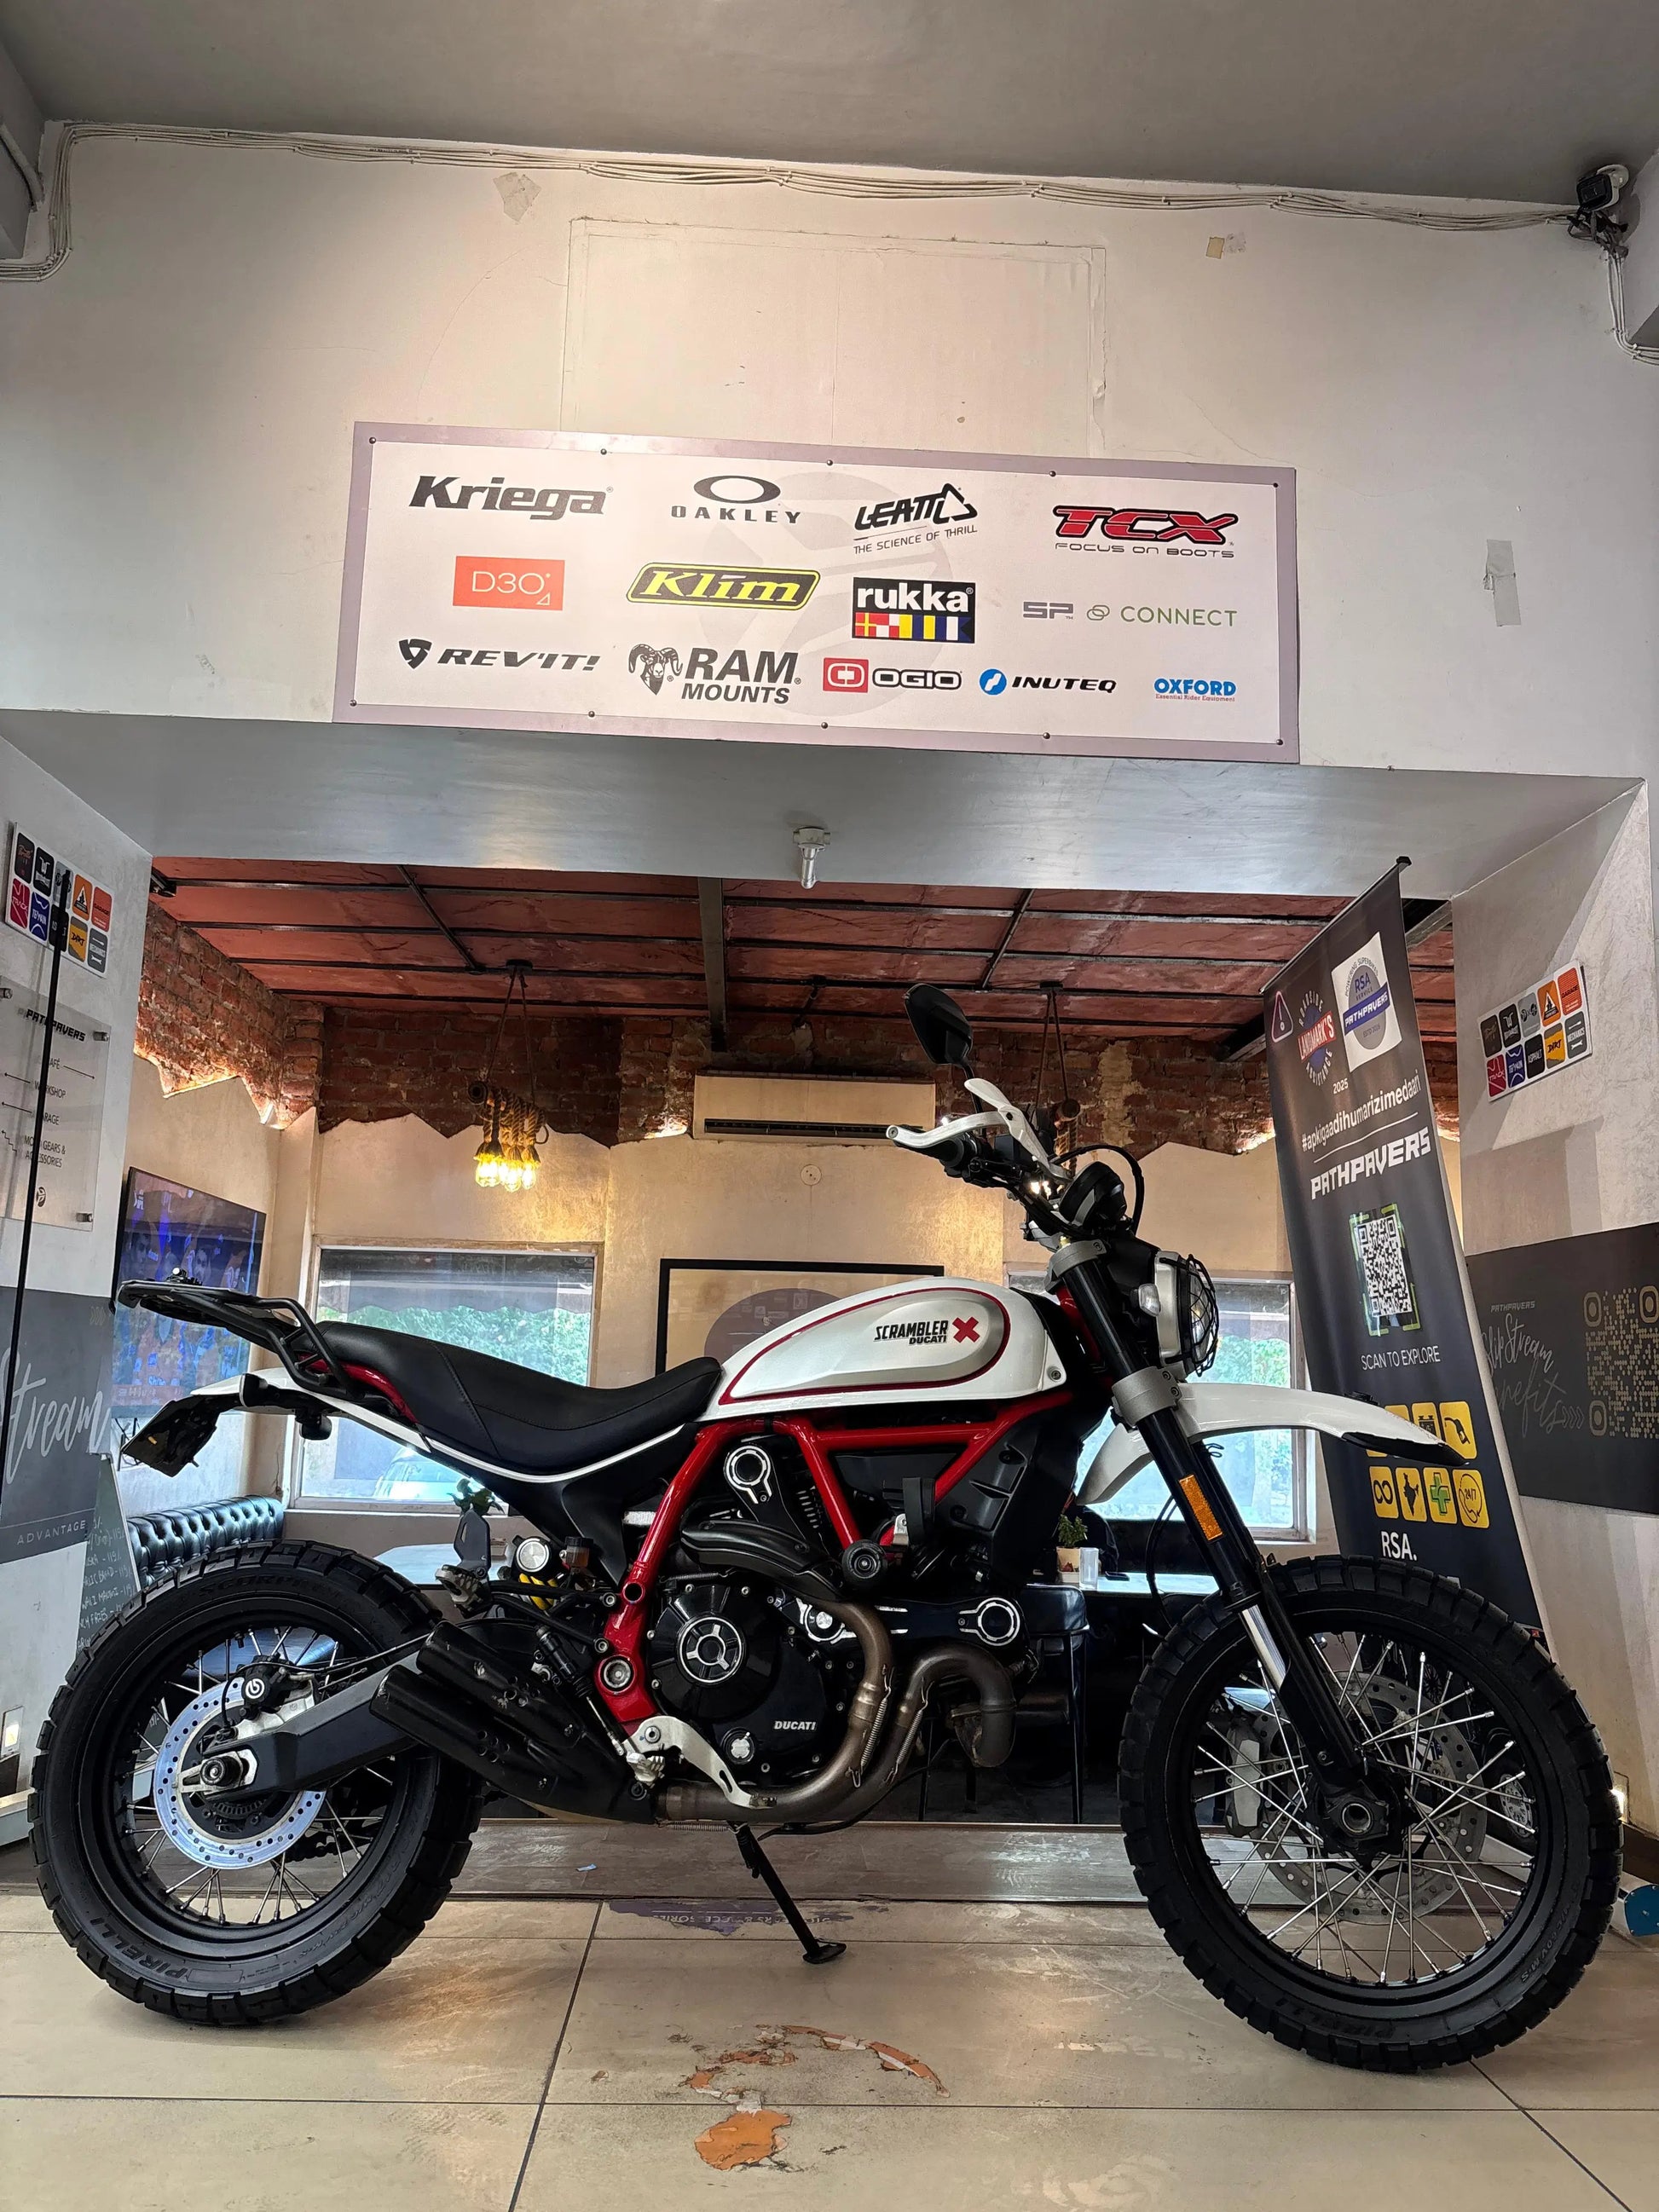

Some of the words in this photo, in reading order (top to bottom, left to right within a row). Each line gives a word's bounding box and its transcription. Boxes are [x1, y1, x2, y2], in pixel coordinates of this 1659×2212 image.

[408, 476, 607, 521] Kriega
[671, 505, 801, 524] OAKLEY
[1052, 505, 1239, 546] TCX
[853, 543, 873, 555] THE
[876, 534, 922, 551] SCIENCE
[926, 531, 940, 542] OF
[945, 525, 978, 540] THRILL
[1055, 542, 1125, 555] FOCUS
[1167, 547, 1235, 559] BOOTS
[857, 581, 969, 613] rukka
[1023, 602, 1074, 620] SP
[1120, 605, 1238, 628] CONNECT
[437, 648, 601, 672] REV'IT!
[685, 648, 798, 683] RAM
[872, 667, 962, 690] OGIO
[1012, 676, 1117, 695] INUTEQ
[1153, 678, 1236, 696] OXFORD
[681, 683, 790, 705] MOUNTS
[1355, 972, 1371, 993] RSA
[1298, 990, 1324, 1027] ROADSIDE
[1345, 991, 1388, 1028] PATHPAVERS
[26, 1008, 86, 1042] PATPAVERS
[1298, 1014, 1334, 1059] LANDMARK'S
[1332, 1077, 1349, 1094] 2025
[43, 1140, 61, 1153] GEARS
[1310, 1126, 1431, 1200] PATHPAVERS
[1491, 1301, 1535, 1313] PATHPAVERS
[875, 1320, 949, 1341] SCRAMBLER
[909, 1335, 947, 1344] DUCATI
[1361, 1352, 1387, 1371] SCAN
[1387, 1350, 1400, 1367] TO
[1401, 1345, 1441, 1366] EXPLORE
[1464, 1488, 1477, 1501] 24/7
[17, 1519, 86, 1545] ADVANTAGE
[1381, 1531, 1417, 1561] RSA.
[774, 1720, 816, 1730] DUCATI
